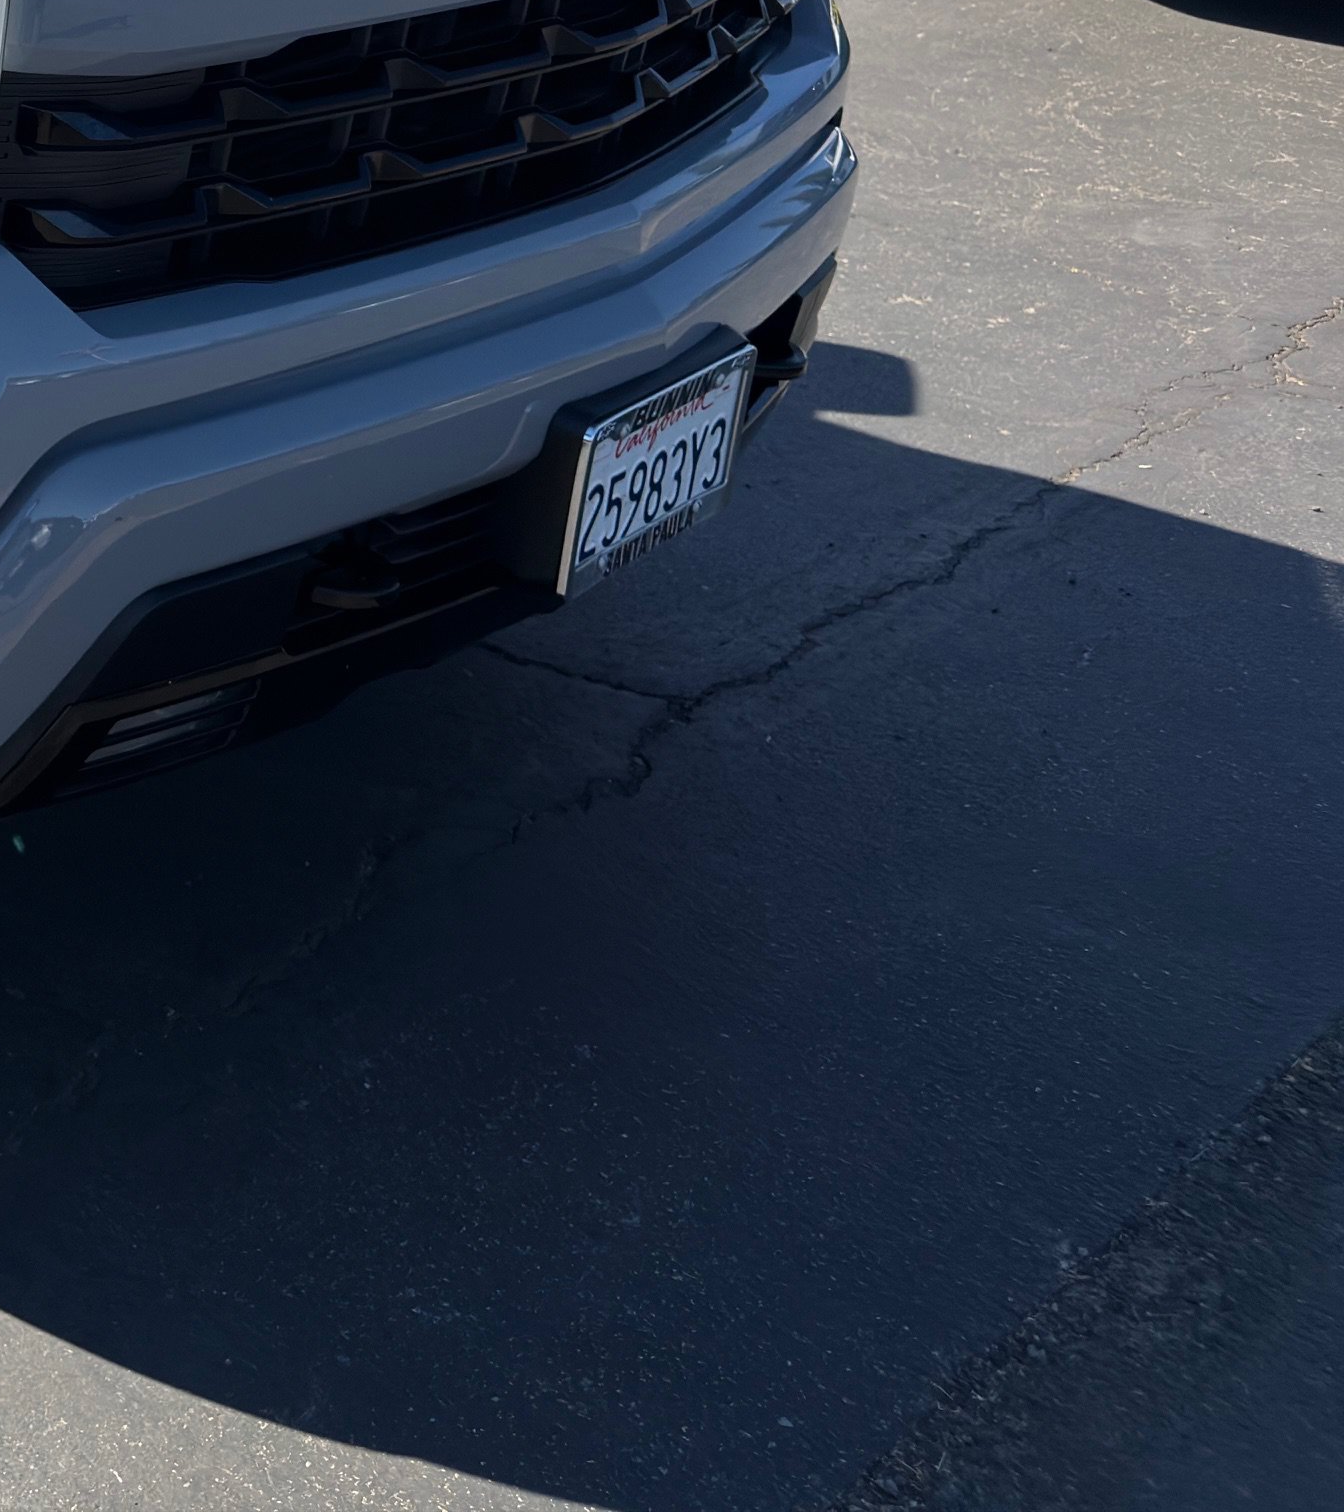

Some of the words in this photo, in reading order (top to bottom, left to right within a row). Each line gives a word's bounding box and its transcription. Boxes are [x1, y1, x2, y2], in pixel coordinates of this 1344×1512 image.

[615, 394, 713, 458] California
[631, 370, 714, 429] BUNNIN
[578, 417, 726, 562] 25983Y3
